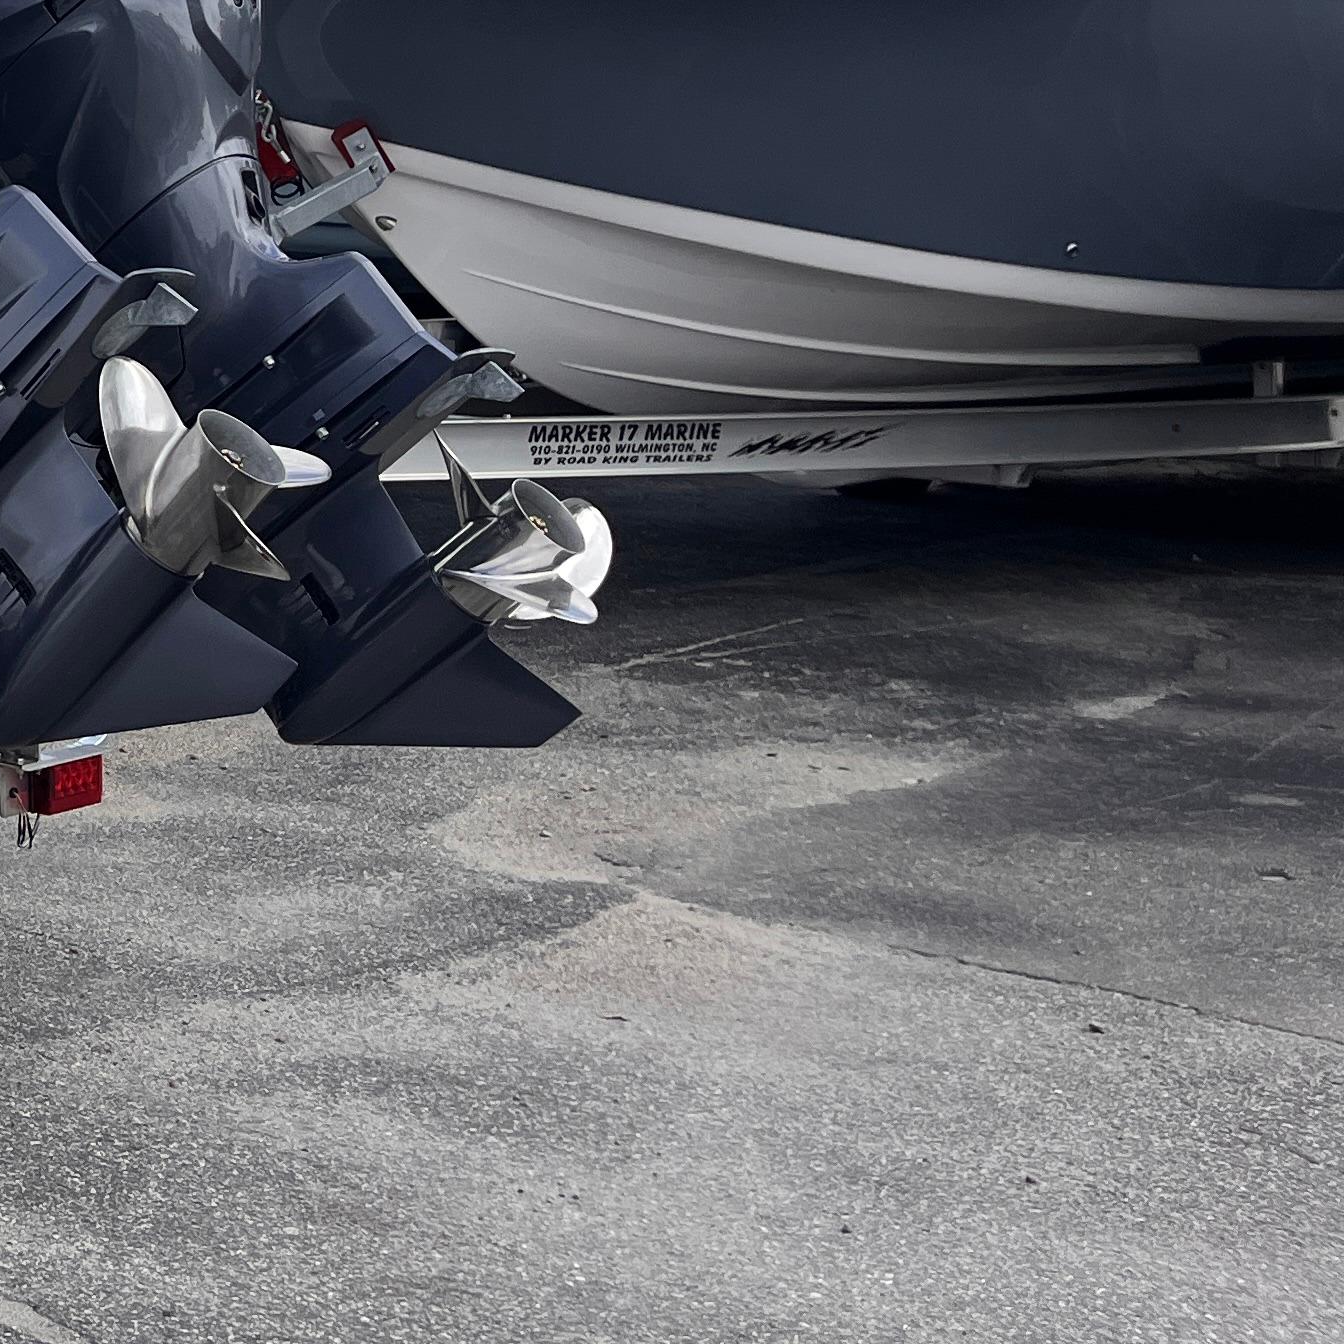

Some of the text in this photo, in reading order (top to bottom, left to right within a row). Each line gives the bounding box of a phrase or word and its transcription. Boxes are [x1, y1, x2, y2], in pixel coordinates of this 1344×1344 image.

[528, 422, 722, 444] MARKER 17 MARINE
[529, 441, 718, 456] 910-821-0190 WILMINGTON, NC
[532, 454, 714, 465] BY ROAD KING TRAILERS
